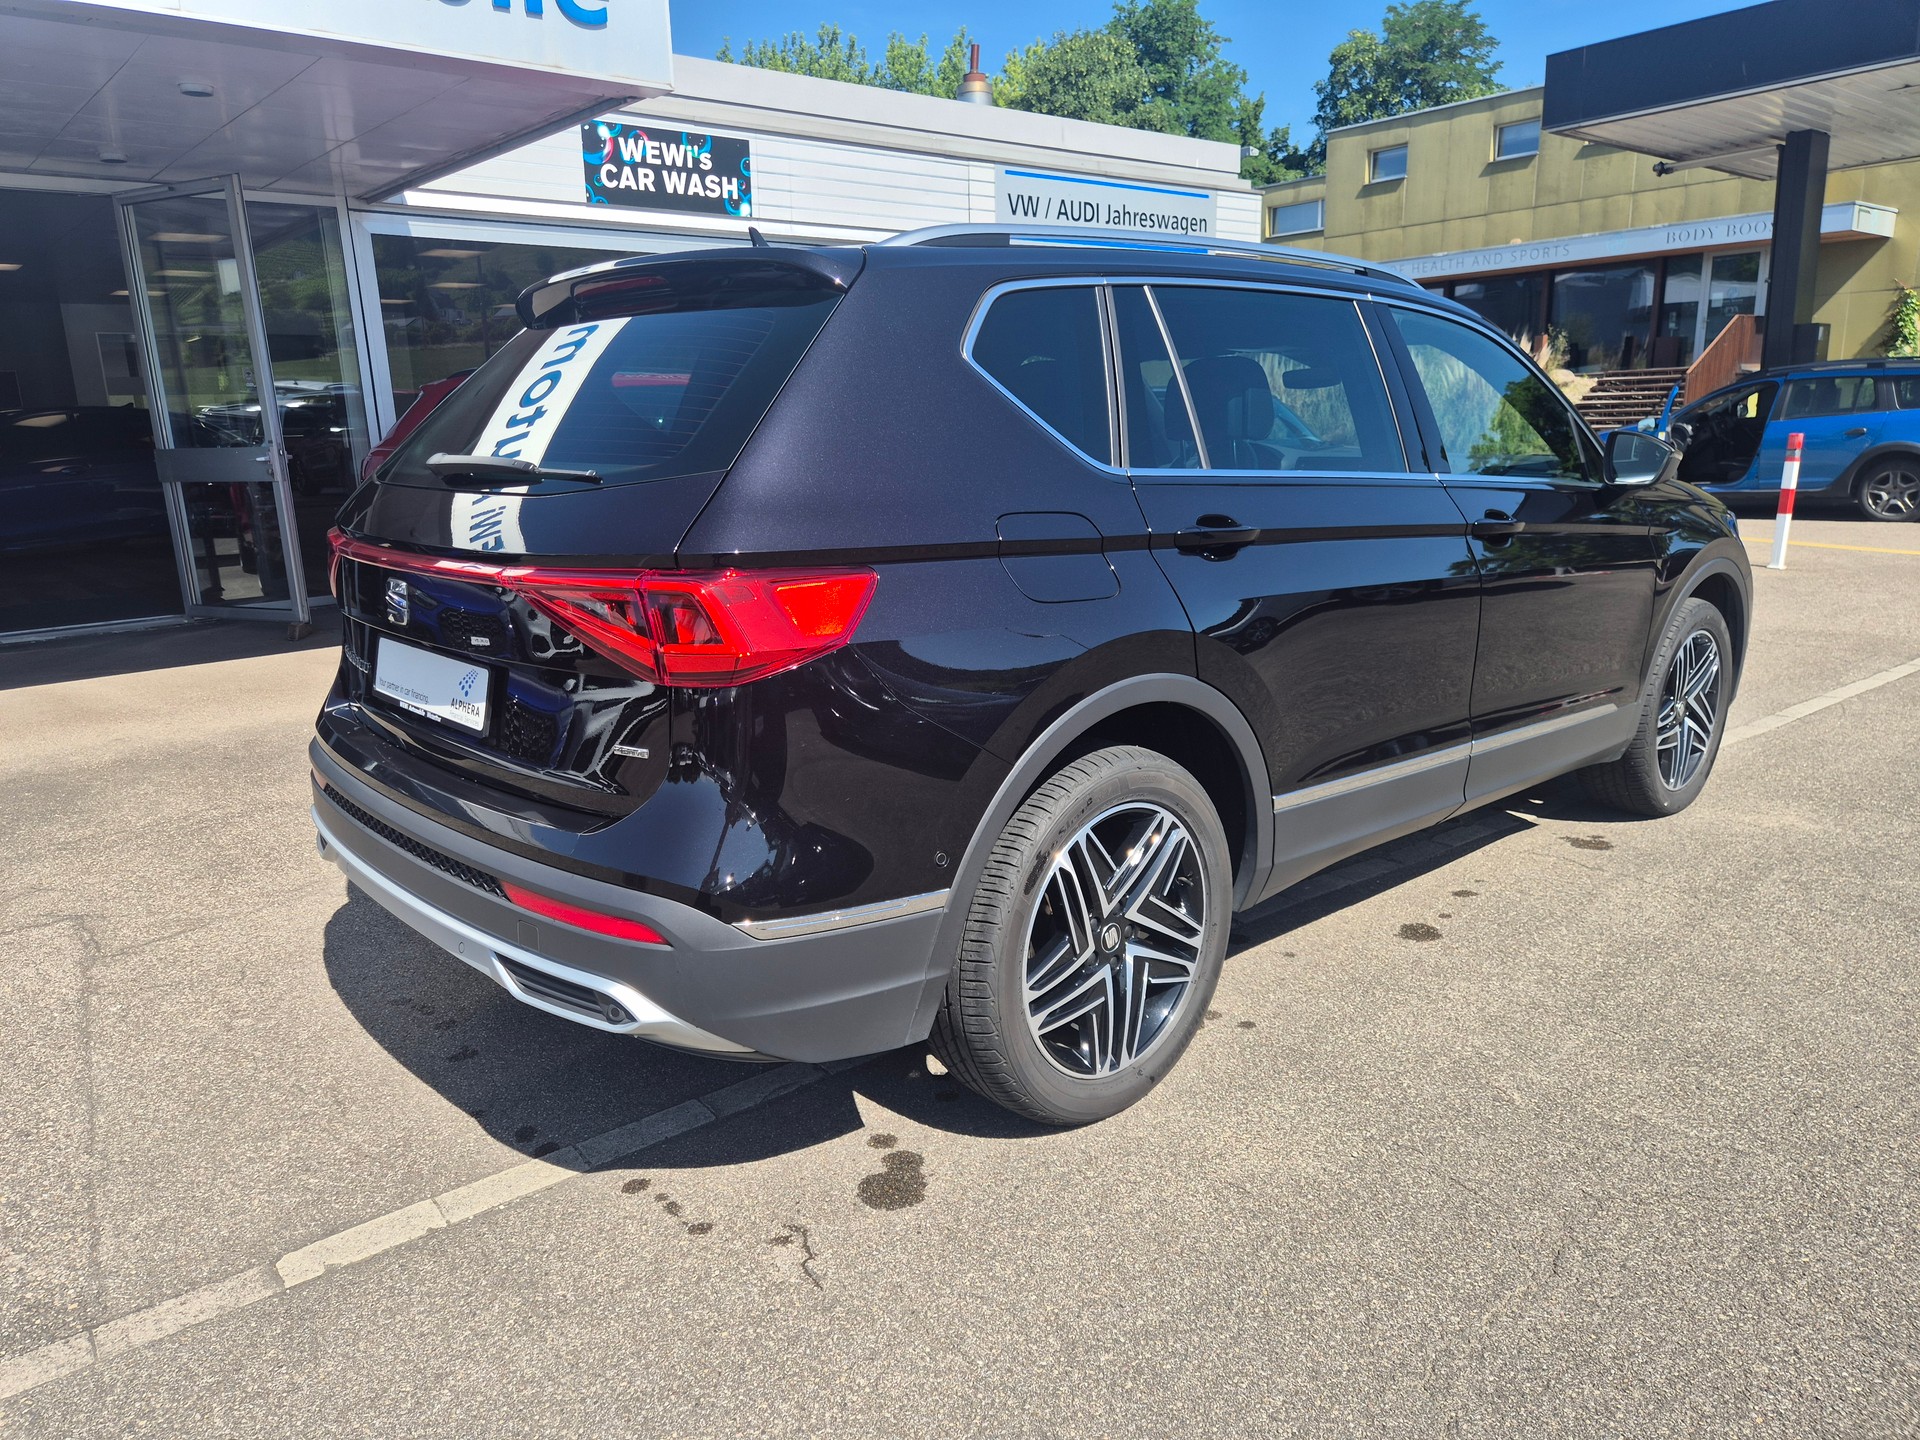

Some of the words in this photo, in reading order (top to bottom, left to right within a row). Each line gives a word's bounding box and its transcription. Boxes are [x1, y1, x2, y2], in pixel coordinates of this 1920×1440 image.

[617, 136, 713, 170] WEWi's
[600, 163, 656, 193] CAR
[662, 169, 739, 200] WASH
[1007, 192, 1040, 218] VW
[1044, 197, 1052, 219] /
[1056, 198, 1100, 224] AUDI
[1105, 204, 1208, 235] Jahreswagen
[1666, 227, 1717, 244] BODY
[1412, 257, 1465, 274] HEALTH
[1472, 252, 1503, 267] AND
[1511, 243, 1571, 263] SPORTS
[450, 697, 480, 718] ALPHERA
